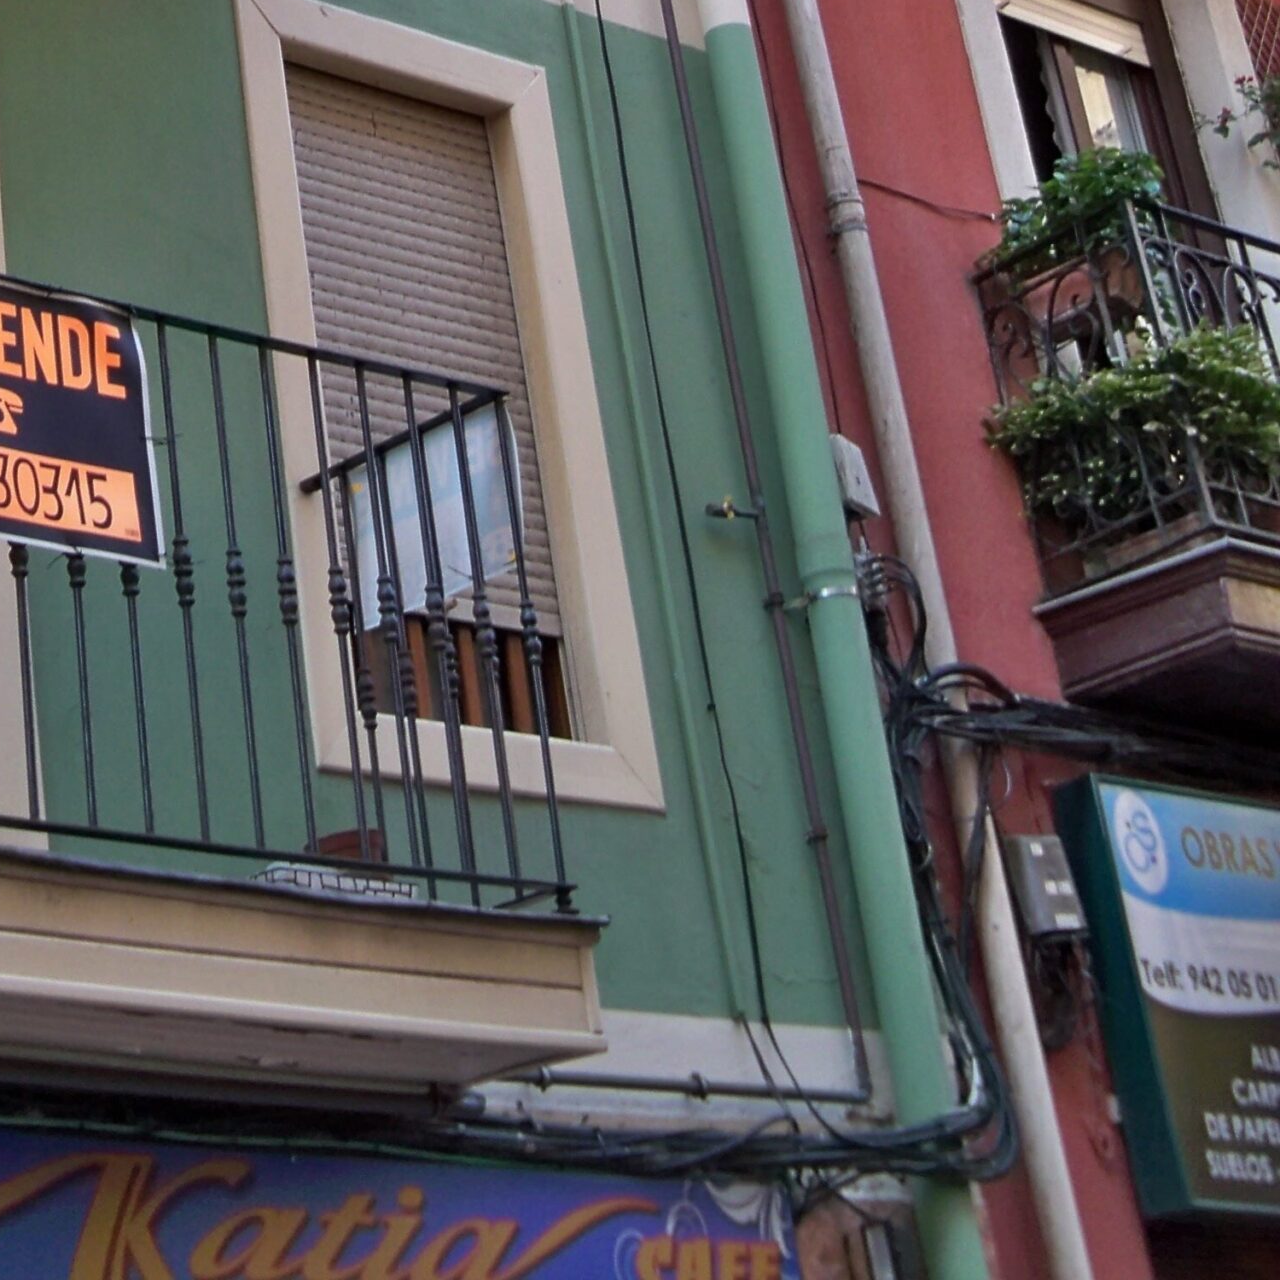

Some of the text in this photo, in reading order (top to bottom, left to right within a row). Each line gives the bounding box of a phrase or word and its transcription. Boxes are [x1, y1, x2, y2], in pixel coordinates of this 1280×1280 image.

[1181, 826, 1275, 879] OBRAS
[1187, 964, 1224, 995] 942
[1227, 968, 1252, 999] 05
[1204, 1111, 1231, 1141] DE
